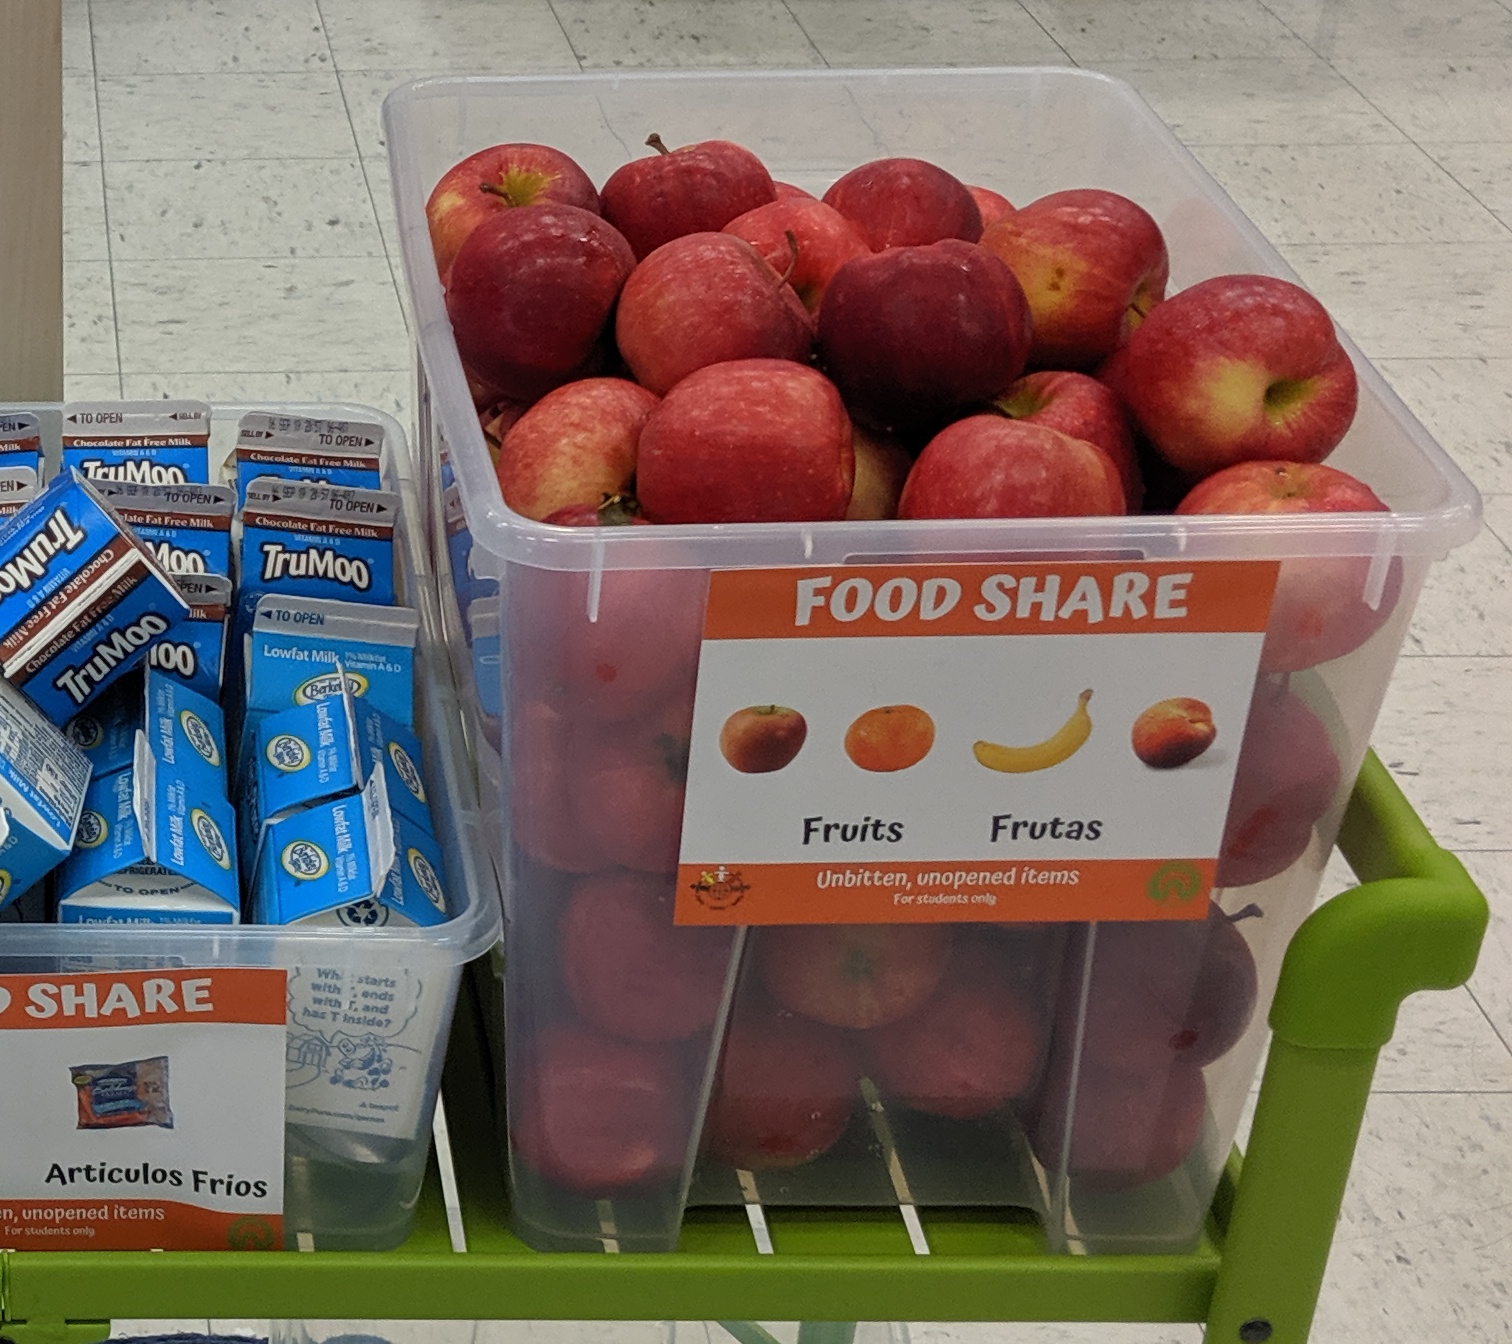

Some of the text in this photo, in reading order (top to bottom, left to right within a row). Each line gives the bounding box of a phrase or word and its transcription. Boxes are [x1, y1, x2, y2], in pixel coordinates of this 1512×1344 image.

[79, 412, 124, 424] TO OPEN
[0, 442, 22, 452] Milk
[73, 437, 192, 448] Chocolate Fat Free Milk
[319, 434, 363, 447] TO OPEN
[249, 452, 366, 468] Chocolate Milk
[83, 460, 186, 486] TruMoo
[164, 492, 212, 505] TO OPEN
[330, 499, 376, 513] TO OPEN
[145, 514, 162, 524] Fat
[164, 516, 188, 527] Free
[189, 517, 214, 528] Milk
[255, 517, 378, 538] Chocolate Fat Free Milk
[262, 543, 369, 590] TruMoo
[2, 548, 115, 650] Chocolate Fat Free Milk
[794, 571, 1194, 626] FOOD SHARE
[24, 575, 139, 674] Chocolate Fat Milk
[275, 609, 325, 626] TO OPEN
[56, 614, 168, 705] TruMoo
[263, 644, 341, 664] Lowfat Milk
[802, 814, 906, 846] Fruits
[990, 813, 1104, 843] Frutas
[816, 865, 1080, 891] Unbitten, unopened items
[114, 884, 180, 896] TO OPEN
[893, 892, 914, 905] For
[915, 892, 969, 905] students
[356, 975, 397, 988] starts
[24, 976, 215, 1020] SHARE
[311, 982, 395, 1002] with ends
[312, 997, 389, 1015] with and
[302, 1007, 392, 1028] has T inside?
[44, 1161, 269, 1200] Articulos Frios
[22, 1204, 110, 1224] unopened
[113, 1204, 166, 1221] items
